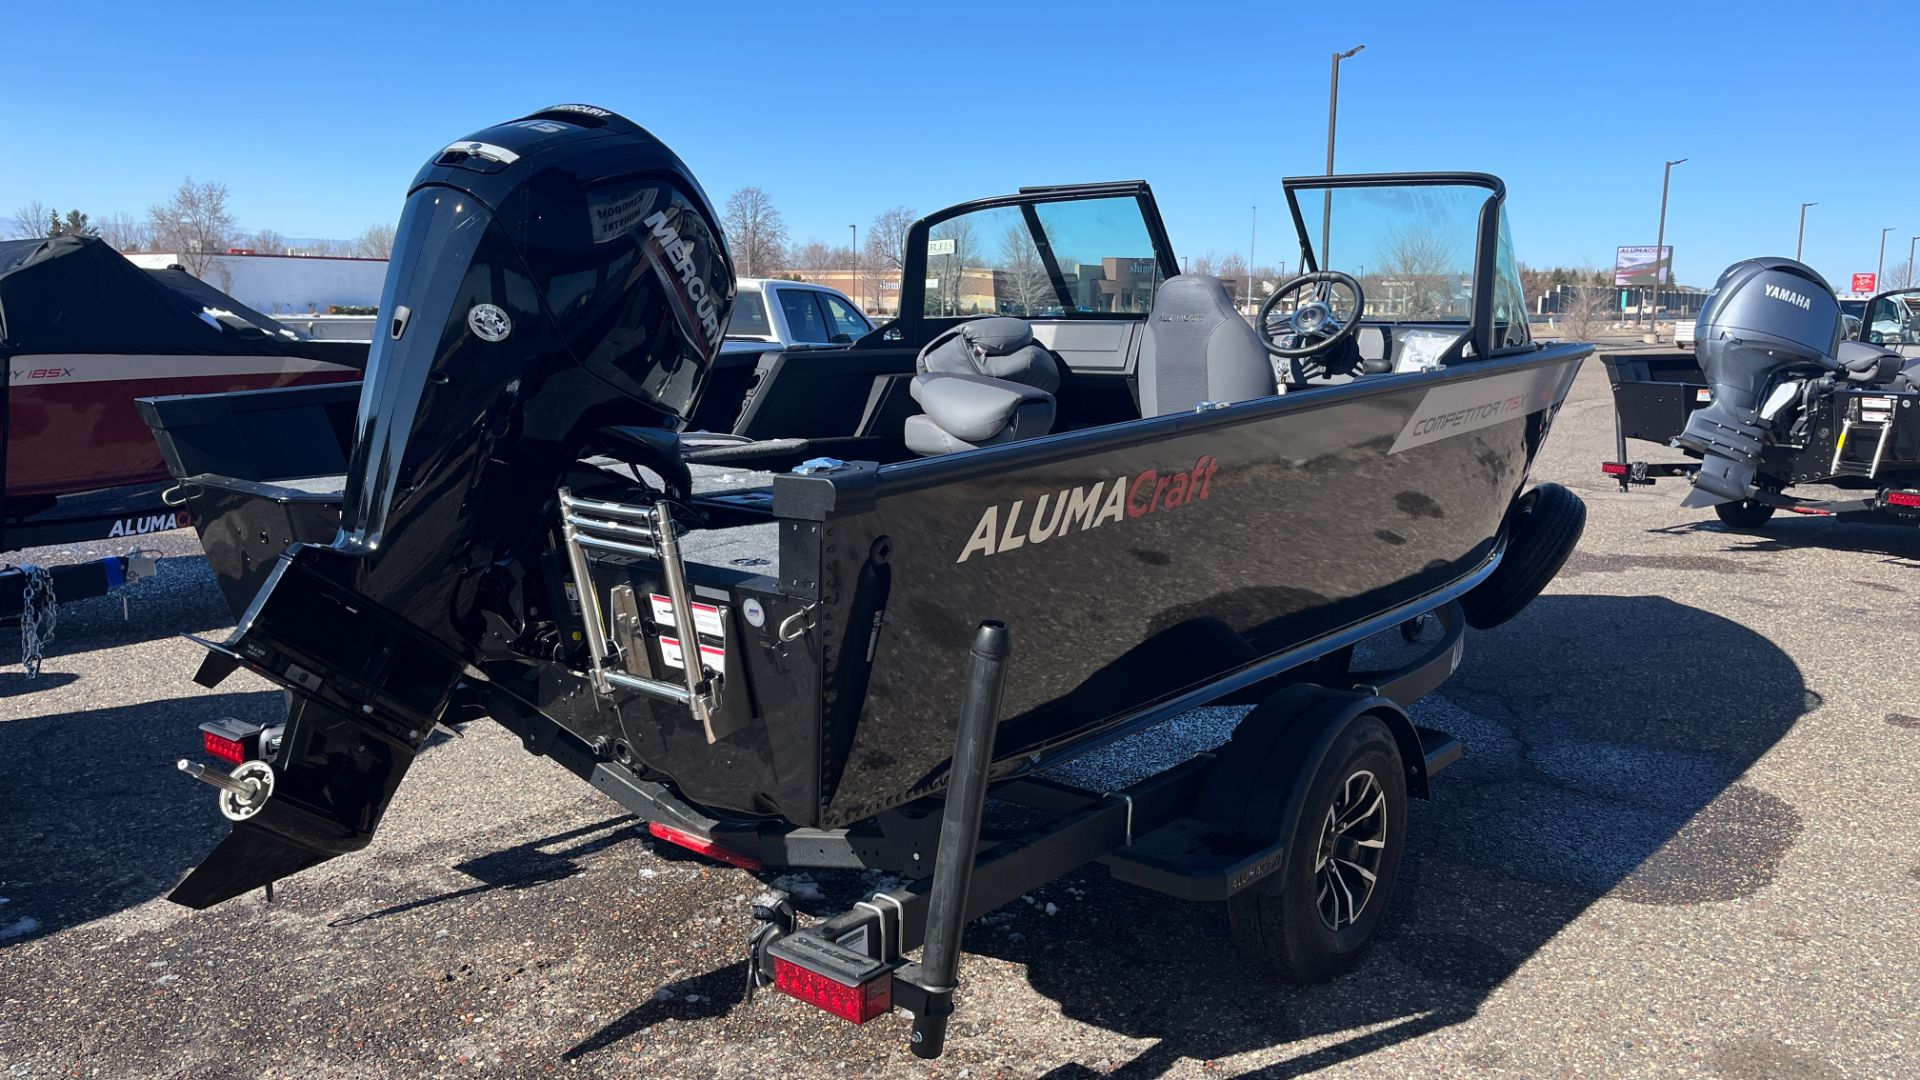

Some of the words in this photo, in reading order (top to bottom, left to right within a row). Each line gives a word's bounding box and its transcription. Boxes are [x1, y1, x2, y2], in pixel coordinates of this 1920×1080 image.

[552, 104, 612, 117] MERCURY
[643, 209, 721, 348] MERCURY
[1765, 283, 1811, 310] YAMAHA
[27, 367, 75, 379] 185X
[1413, 400, 1502, 437] COMPETITOR
[954, 454, 1220, 564] ALUMACraft
